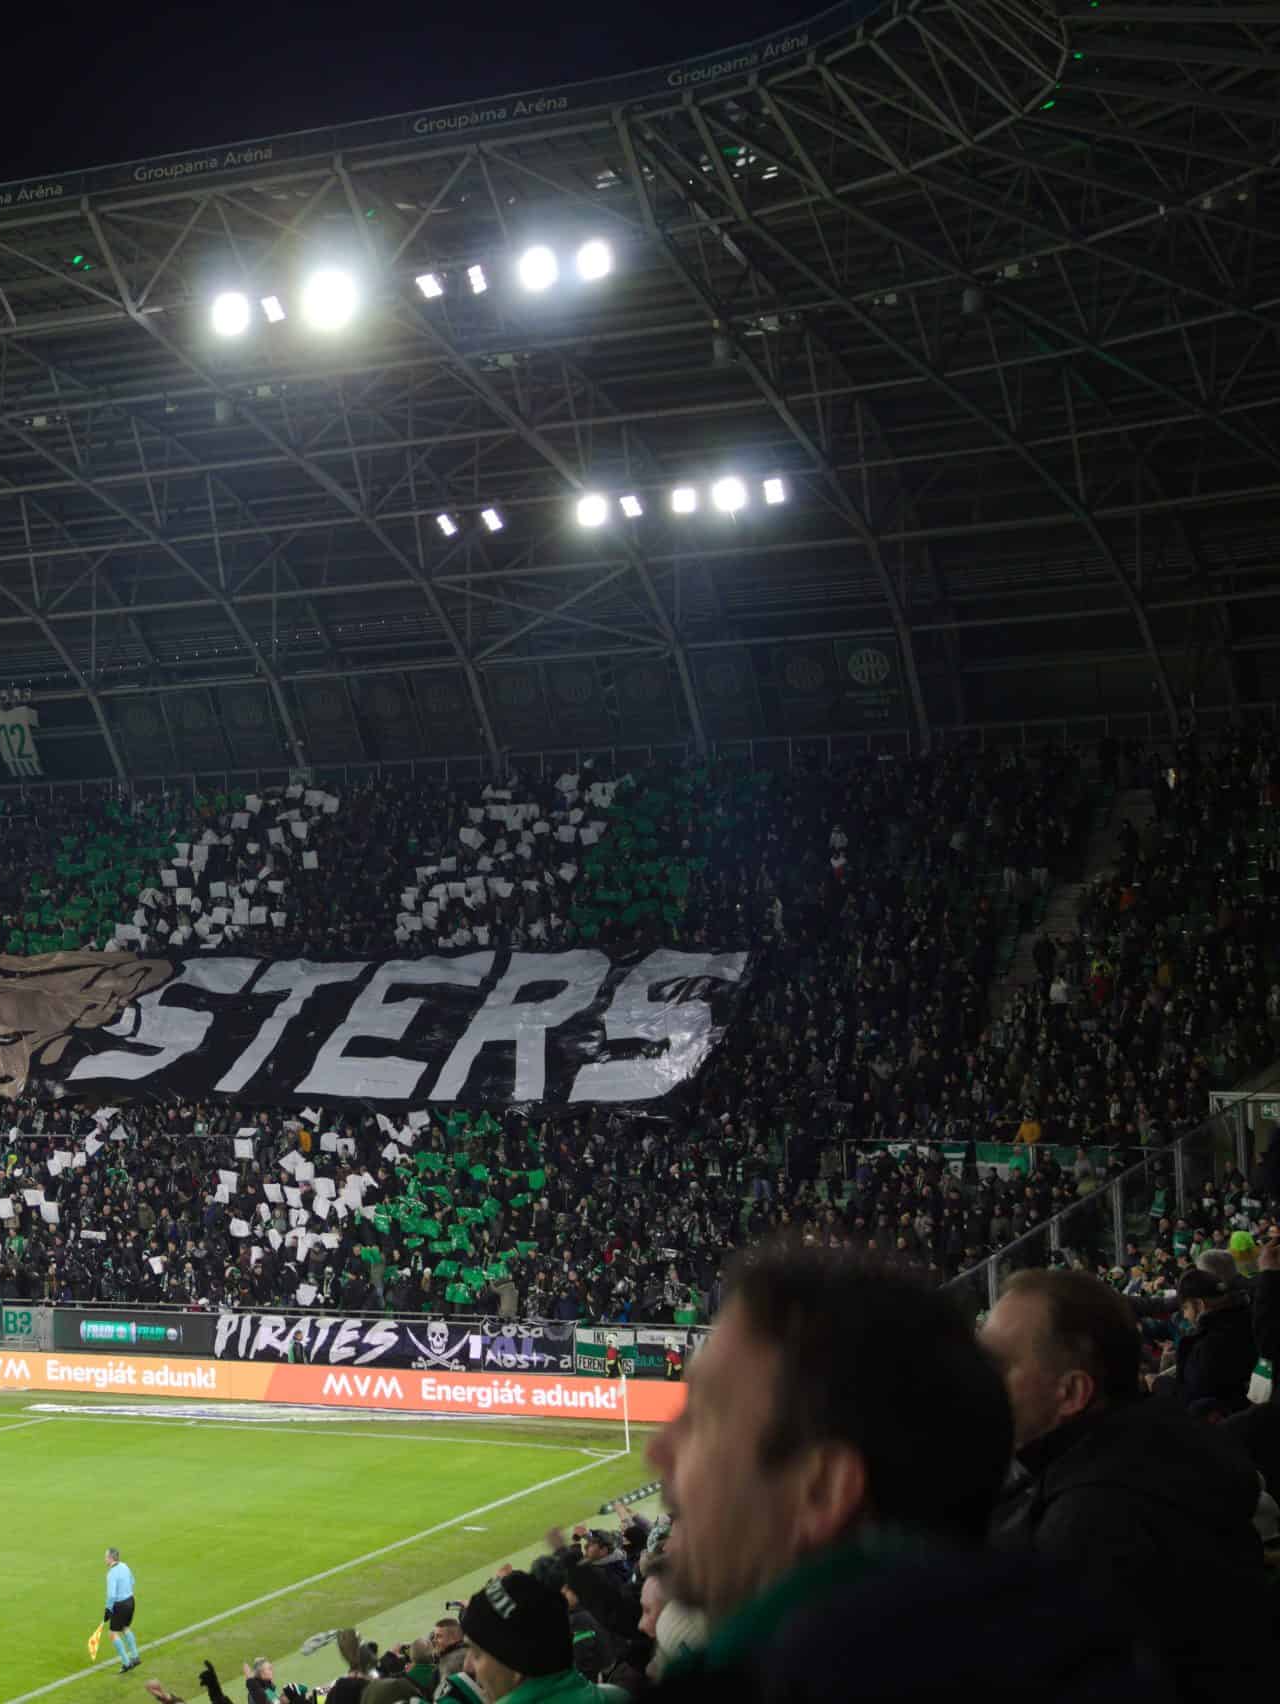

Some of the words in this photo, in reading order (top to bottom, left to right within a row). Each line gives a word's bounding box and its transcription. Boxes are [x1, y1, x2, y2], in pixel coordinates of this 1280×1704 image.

[667, 53, 757, 87] Groupama
[763, 33, 809, 57] Aréna
[414, 108, 507, 135] Groupama
[513, 94, 568, 116] Aréna
[134, 157, 218, 182] Groupama
[223, 145, 273, 167] Aréna
[17, 183, 64, 200] Aréna
[0, 723, 33, 760] 12
[66, 947, 750, 1107] STERS
[214, 1314, 400, 1365] PIRATES
[47, 1360, 136, 1387] Energiát
[142, 1366, 216, 1388] adunk!
[322, 1374, 404, 1399] MVM
[421, 1377, 523, 1407] Energiát
[532, 1384, 618, 1409] adunk!
